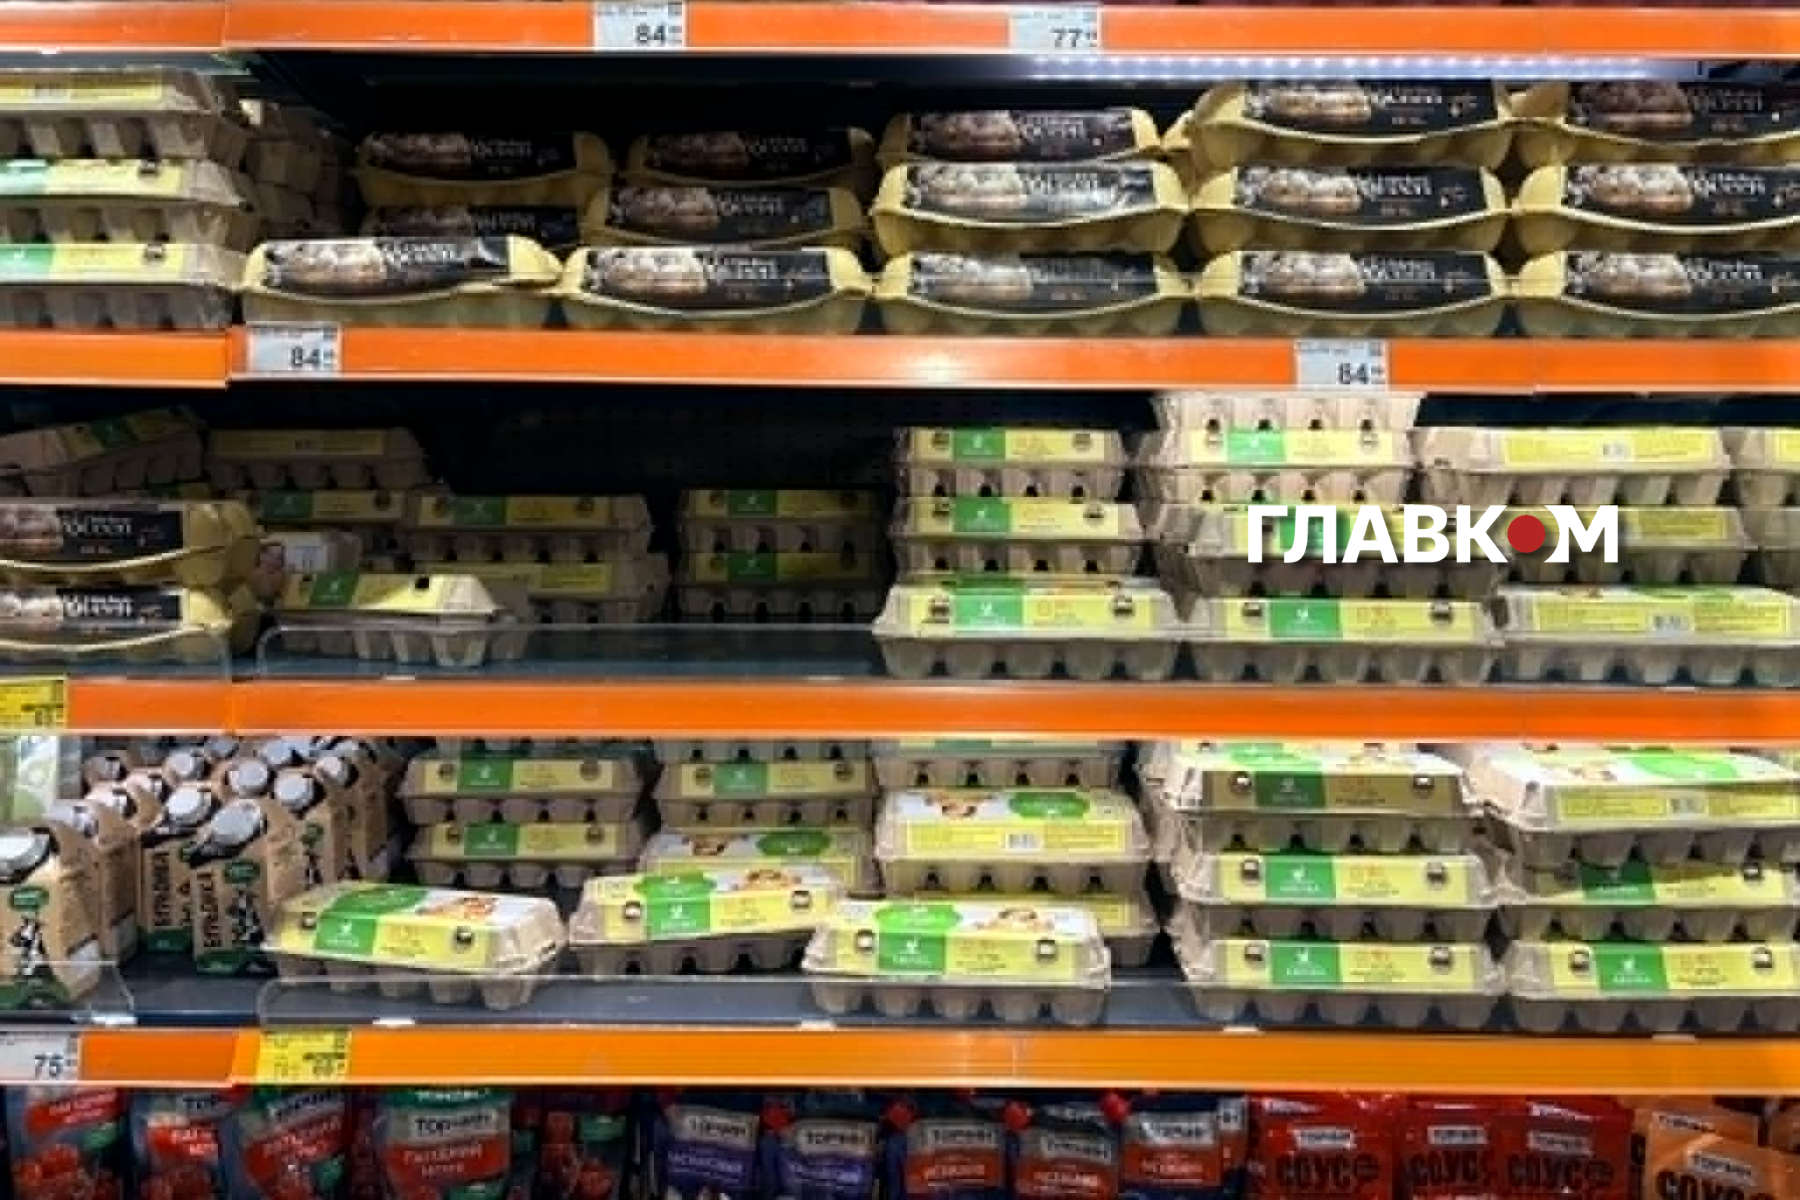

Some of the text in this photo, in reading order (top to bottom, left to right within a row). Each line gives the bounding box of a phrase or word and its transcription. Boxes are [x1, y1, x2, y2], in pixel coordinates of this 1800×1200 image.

[635, 24, 667, 46] 84
[291, 346, 321, 369] 84
[1338, 362, 1370, 385] 84
[34, 1053, 64, 1079] 75
